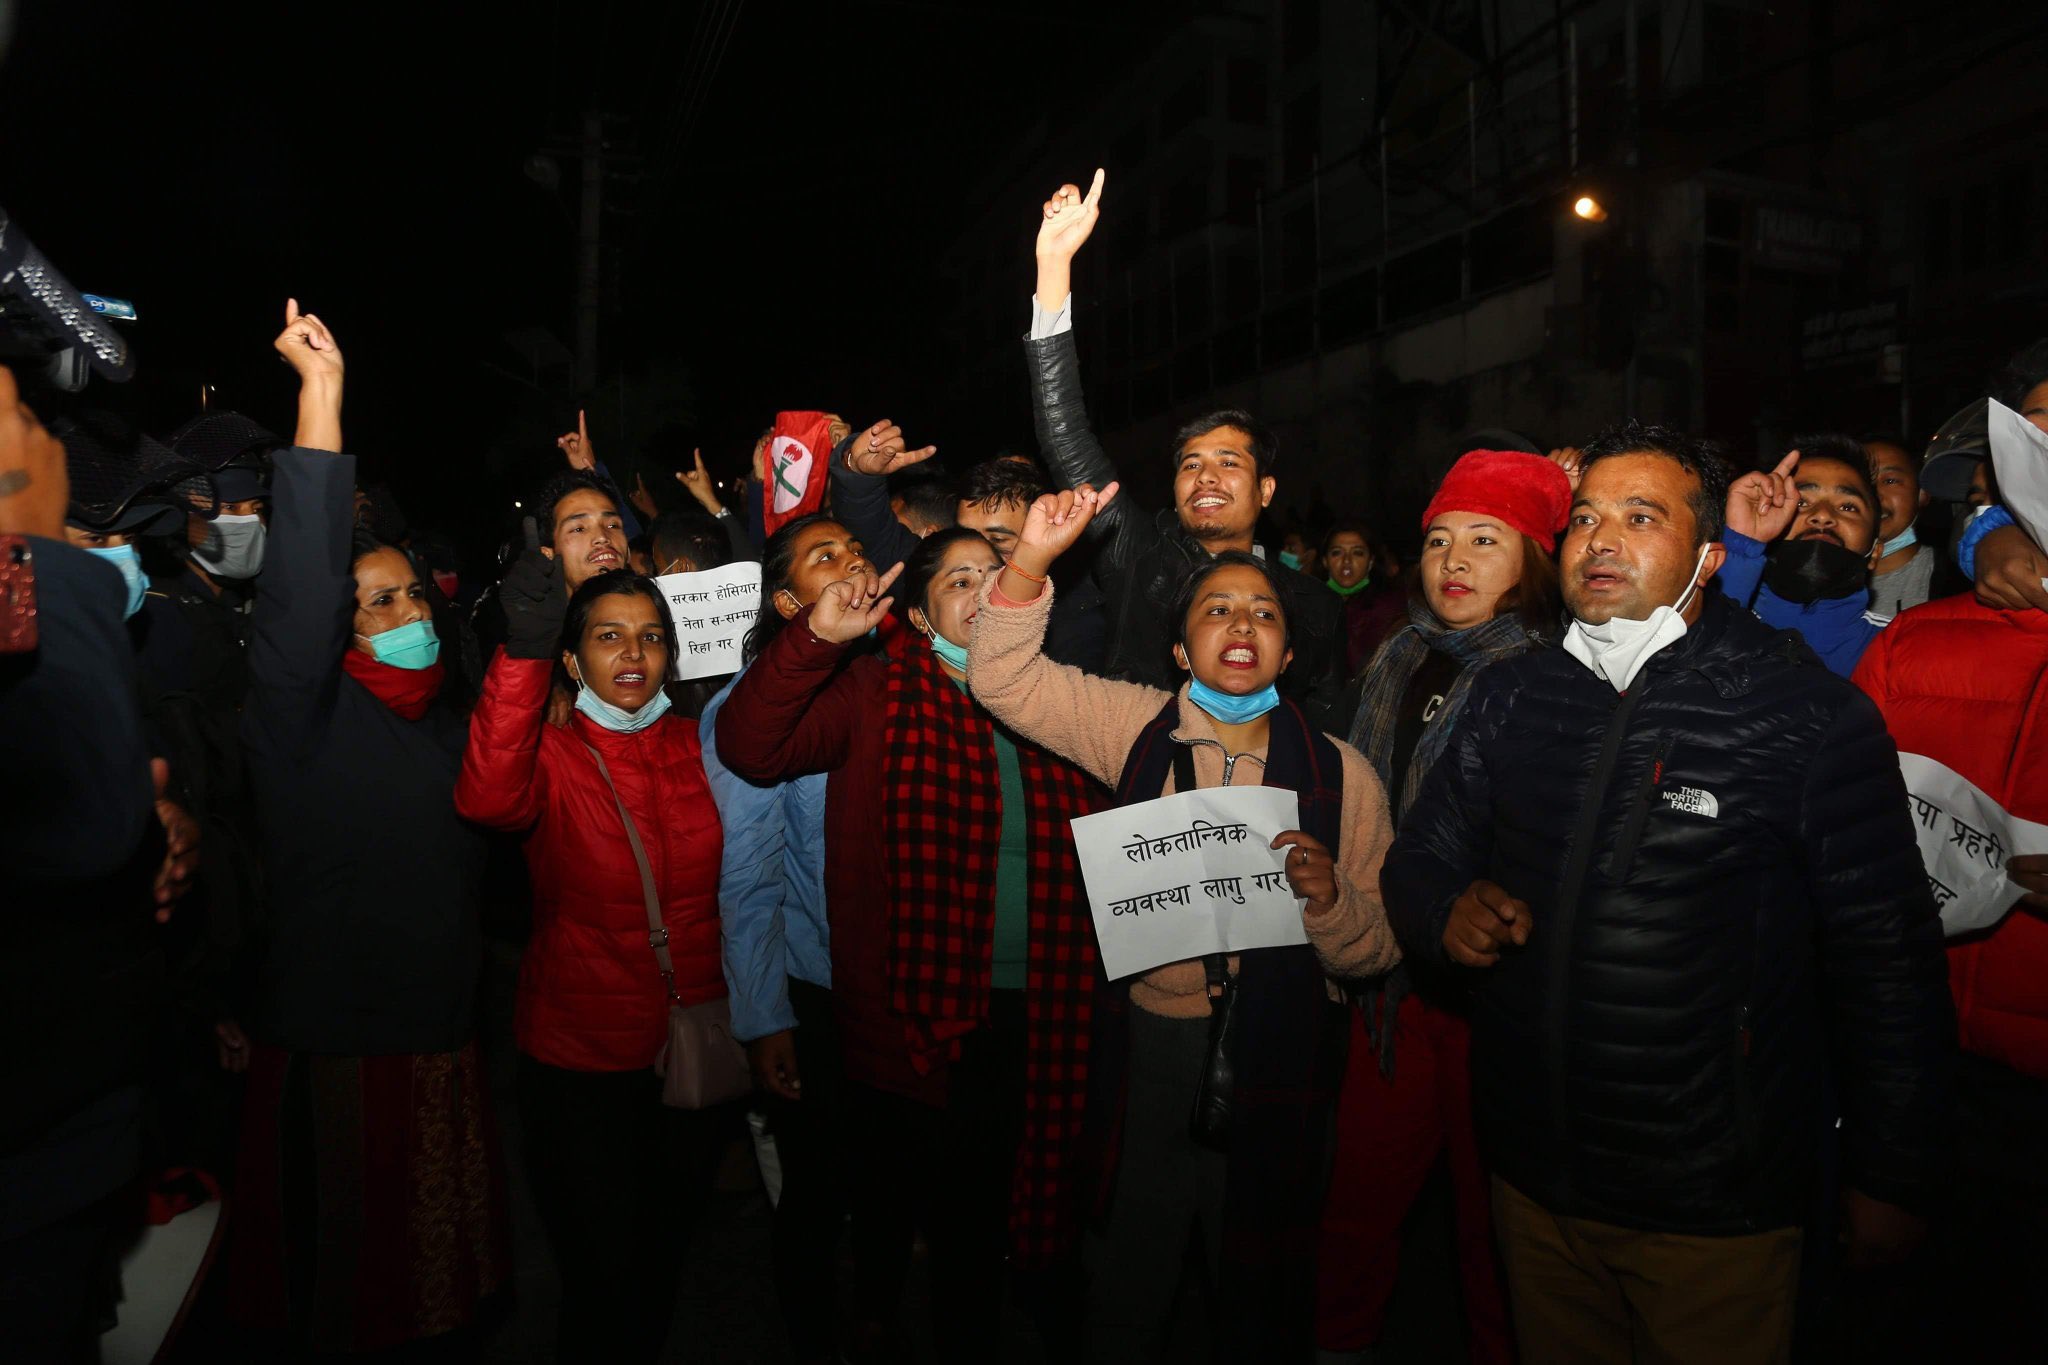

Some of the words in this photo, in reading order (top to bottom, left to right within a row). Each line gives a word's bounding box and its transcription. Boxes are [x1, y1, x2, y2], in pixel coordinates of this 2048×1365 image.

[670, 592, 710, 605] सरकार
[715, 582, 760, 600] होसियार
[682, 616, 704, 630] नेता
[688, 640, 712, 655] रिहा
[716, 638, 735, 650] गर
[1662, 791, 1700, 805] NORTH
[1680, 786, 1702, 798] THE
[1671, 800, 1699, 813] FACE
[1907, 793, 1943, 831] पा
[1949, 816, 2005, 869] प्रहरी
[1122, 820, 1248, 863] लोकतान्त्रिक
[1108, 885, 1191, 916] व्यवस्था
[1199, 877, 1246, 905] लागु
[1250, 871, 1288, 892] गर
